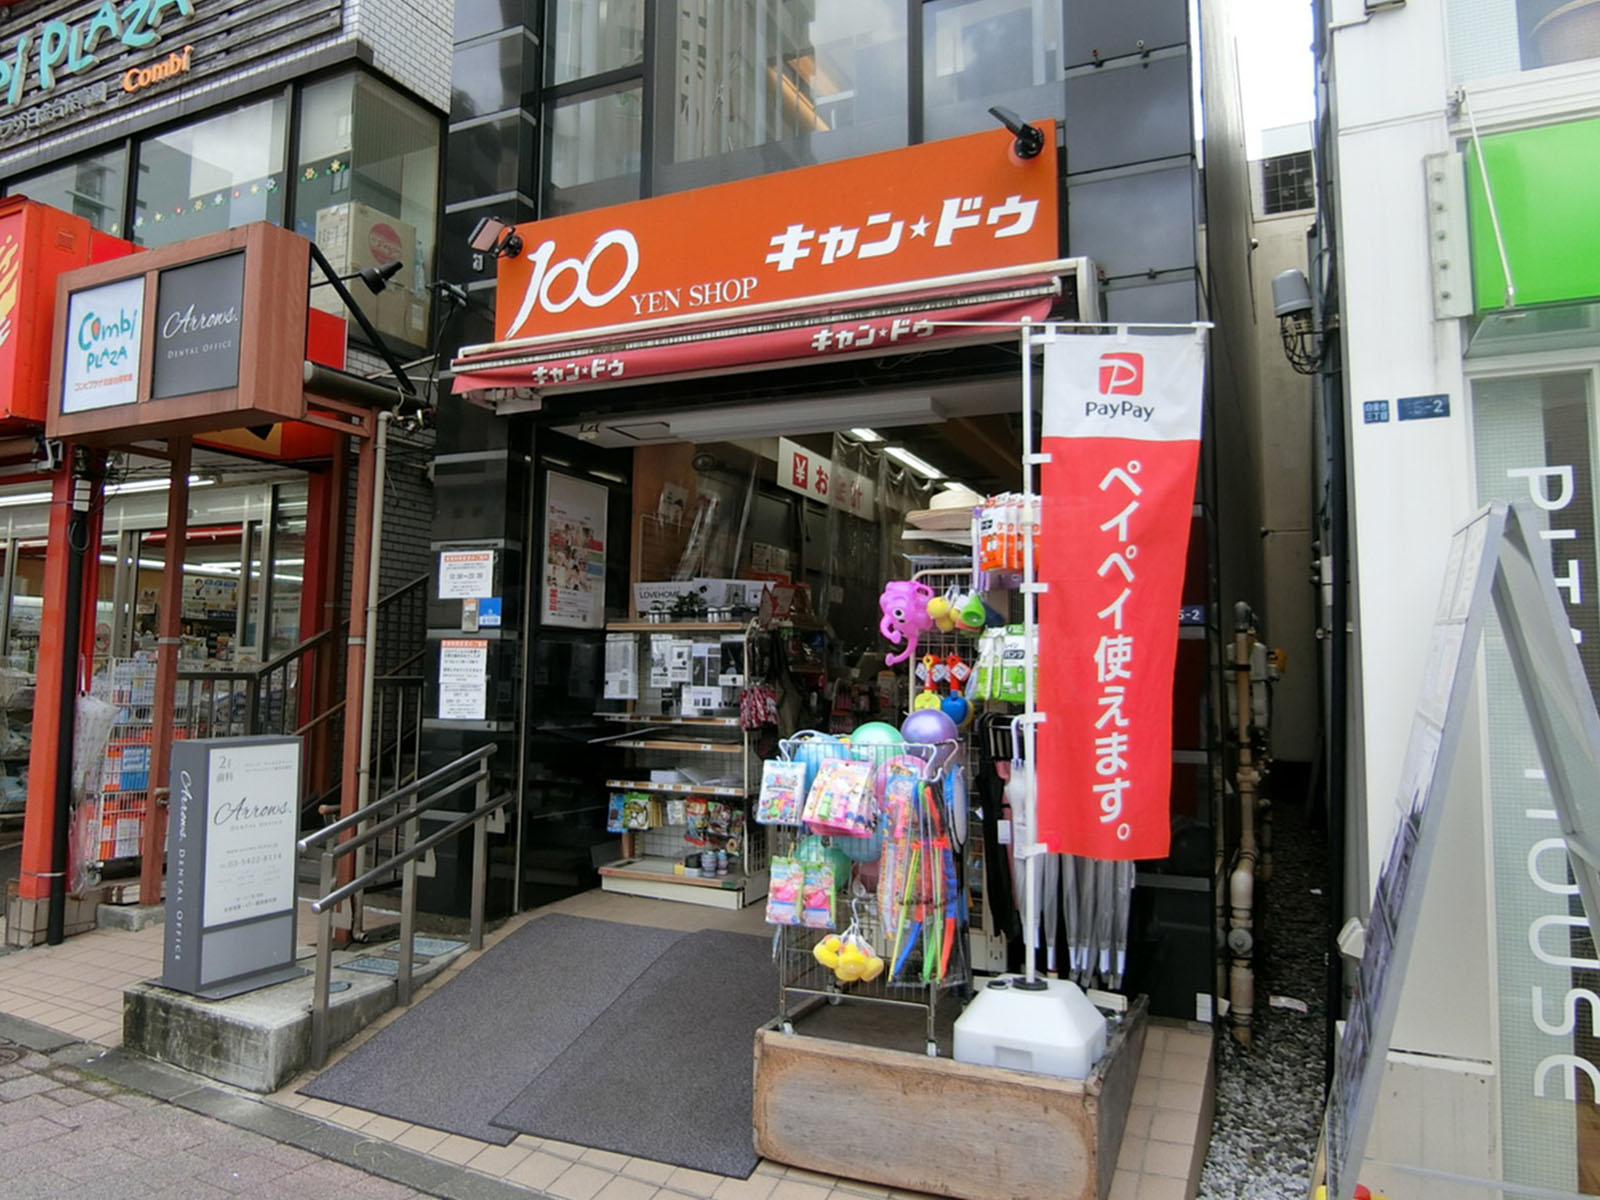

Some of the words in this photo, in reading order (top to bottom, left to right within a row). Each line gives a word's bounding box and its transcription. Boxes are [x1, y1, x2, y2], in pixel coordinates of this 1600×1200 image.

[123, 45, 193, 93] Combi
[505, 228, 639, 340] 100
[630, 288, 683, 315] YEN
[688, 276, 759, 307] SHOP
[78, 308, 138, 351] Combi
[167, 346, 200, 360] DENTAL
[202, 339, 232, 354] OFFICE
[86, 346, 129, 374] PLAZA
[1085, 401, 1155, 423] PayPay
[1092, 460, 1142, 841] ペイペイ使えます。
[176, 848, 186, 902] DENTAL
